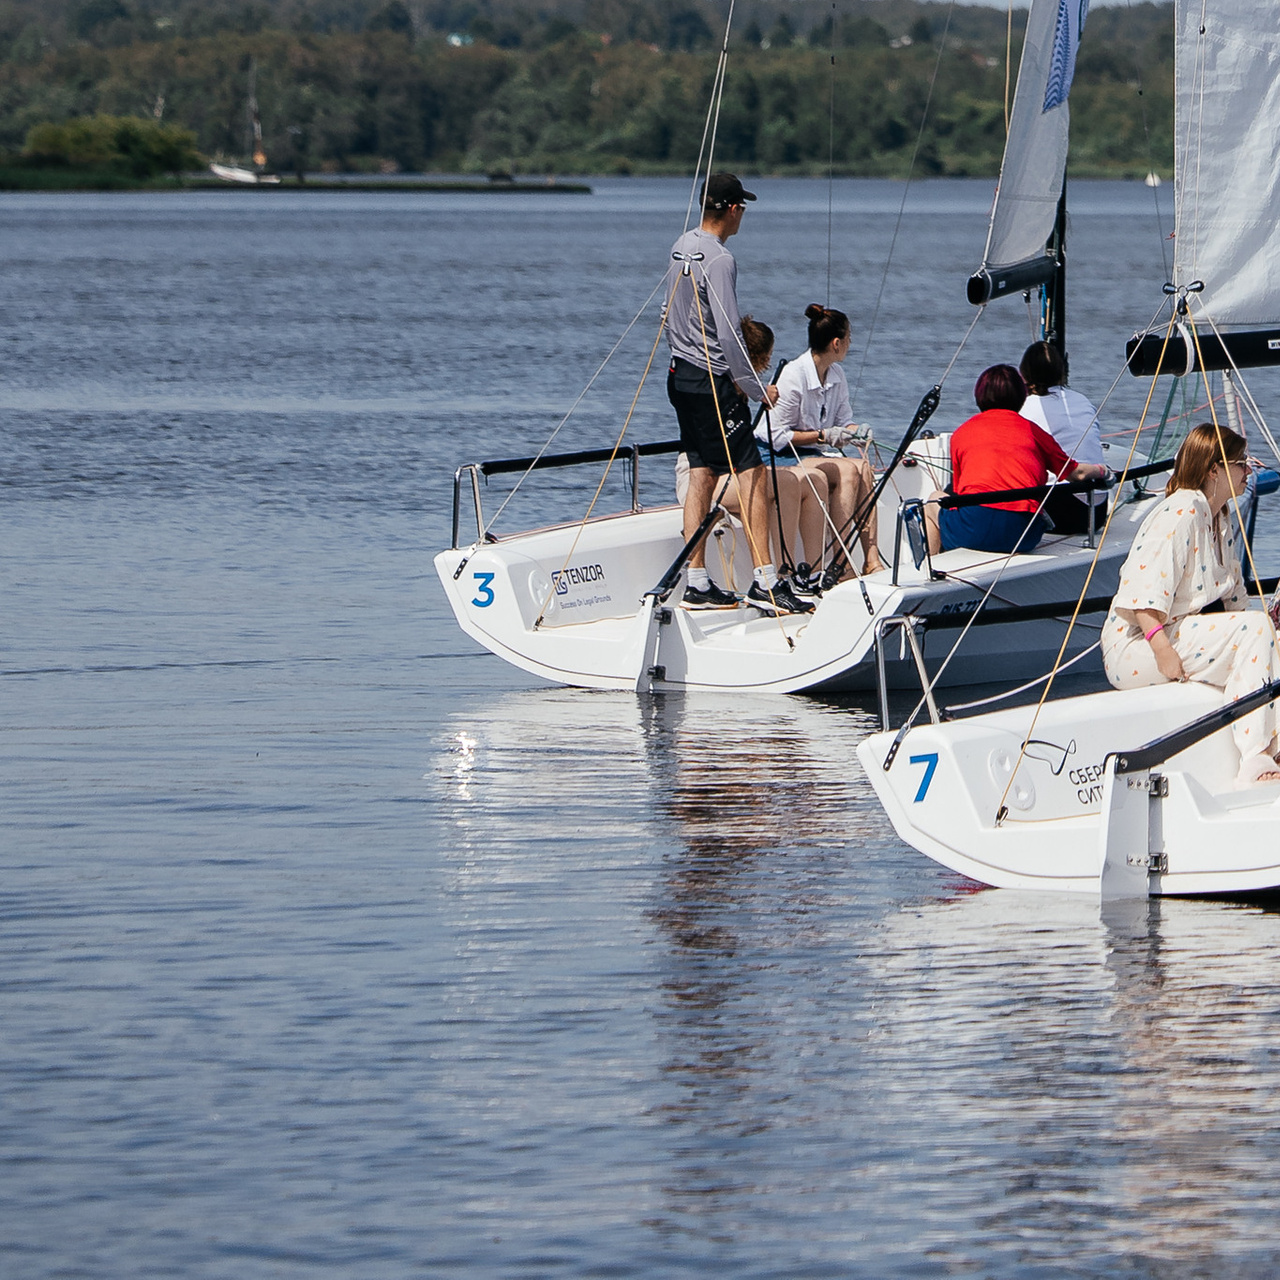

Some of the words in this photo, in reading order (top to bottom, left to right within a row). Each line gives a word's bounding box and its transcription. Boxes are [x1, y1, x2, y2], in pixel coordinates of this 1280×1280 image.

[564, 564, 606, 586] TENZOR
[471, 572, 495, 608] 3
[909, 753, 940, 804] 7
[1077, 785, 1104, 805] СИТ
